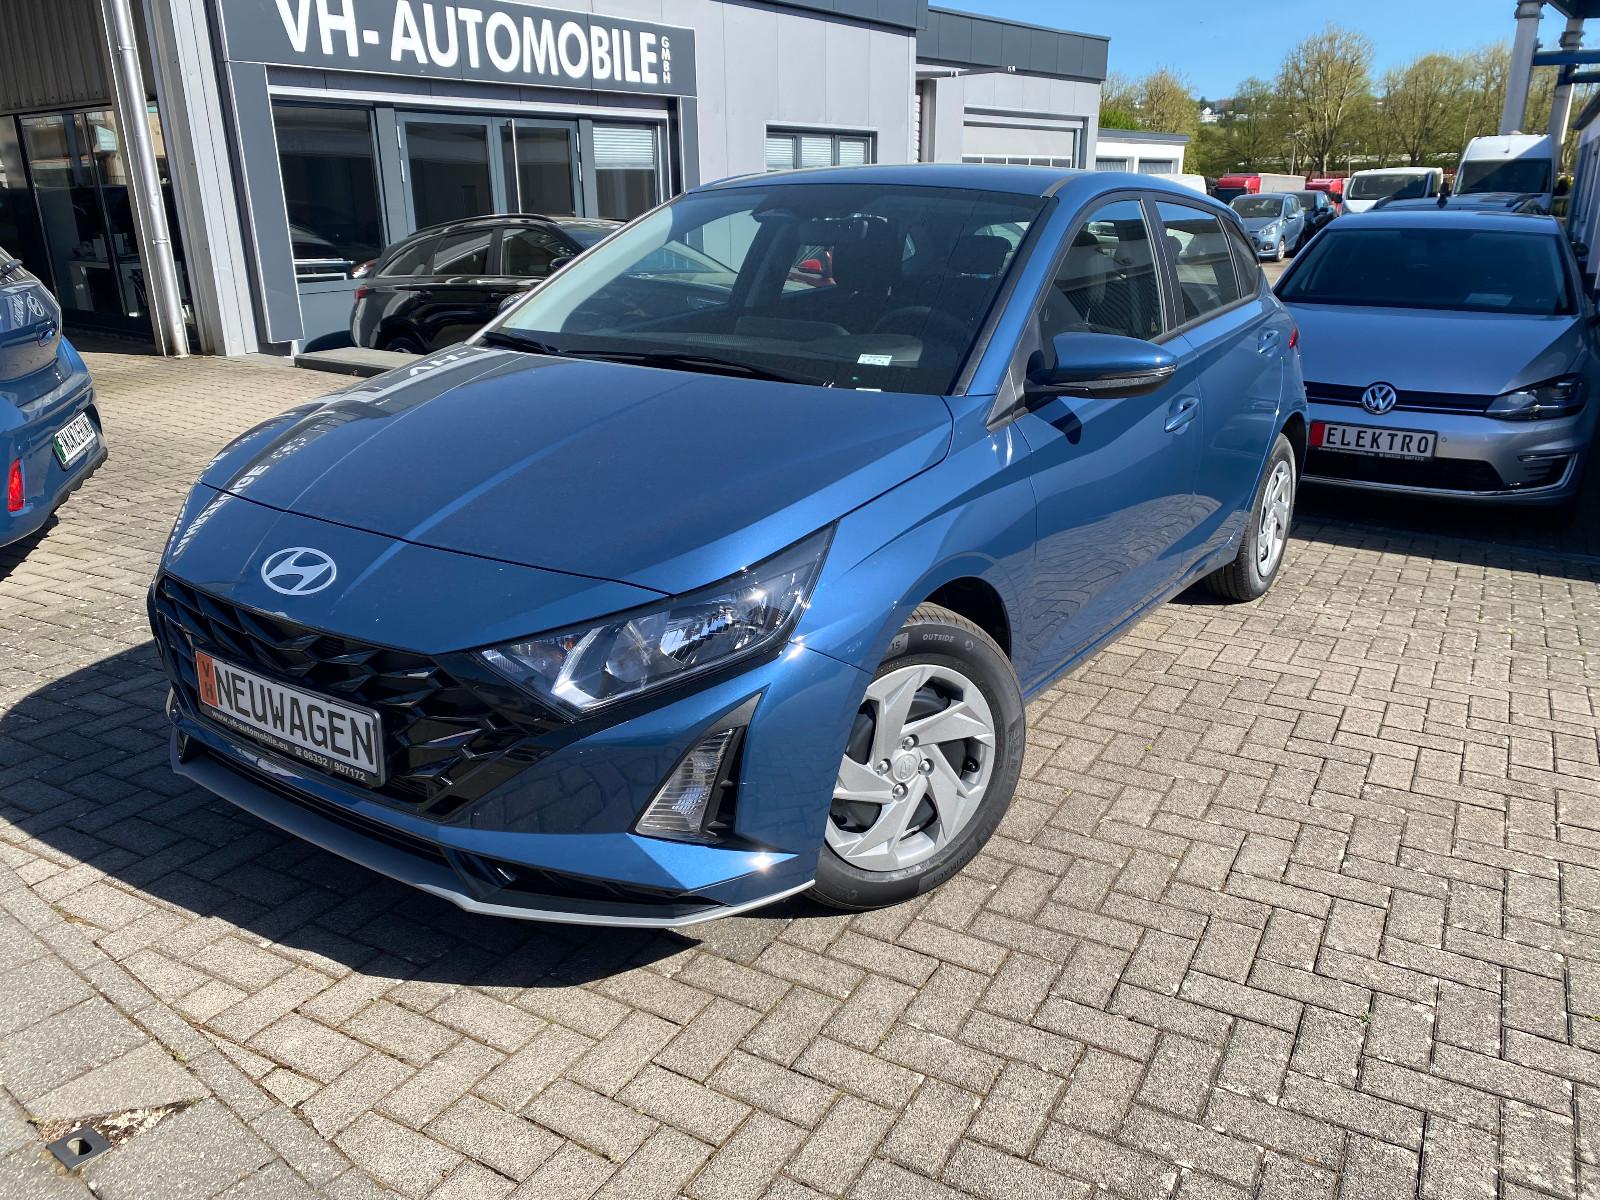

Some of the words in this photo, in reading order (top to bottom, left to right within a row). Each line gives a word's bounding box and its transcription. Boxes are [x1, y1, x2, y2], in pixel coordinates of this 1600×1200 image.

[1326, 427, 1429, 454] ELEKTRO
[922, 633, 956, 643] OUTSIDE
[214, 665, 374, 767] NEUWAGEN
[212, 710, 289, 751] www.vh-automobile.eu
[334, 761, 367, 781] 907172
